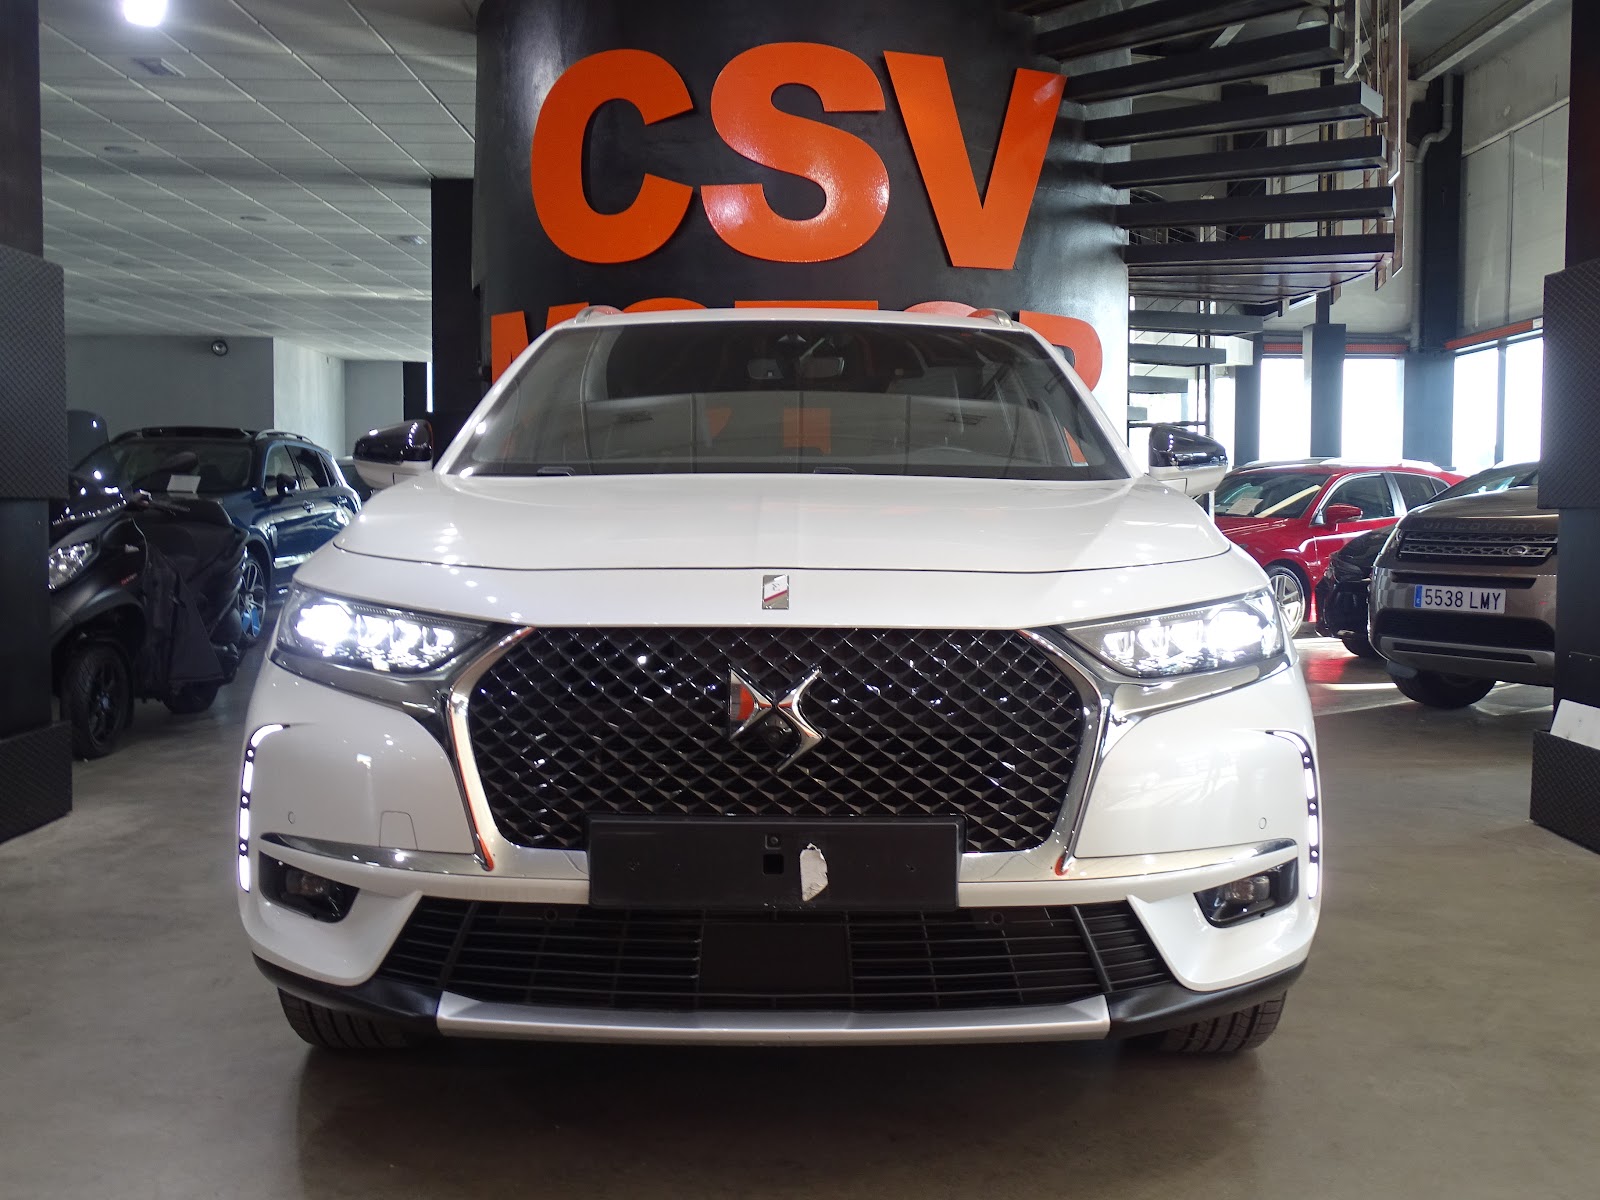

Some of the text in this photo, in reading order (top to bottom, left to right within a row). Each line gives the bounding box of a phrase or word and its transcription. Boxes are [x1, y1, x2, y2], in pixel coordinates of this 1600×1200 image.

[531, 42, 1067, 270] CSV
[1423, 522, 1544, 532] DISCOVERY
[1424, 588, 1501, 611] 5538 LMY
